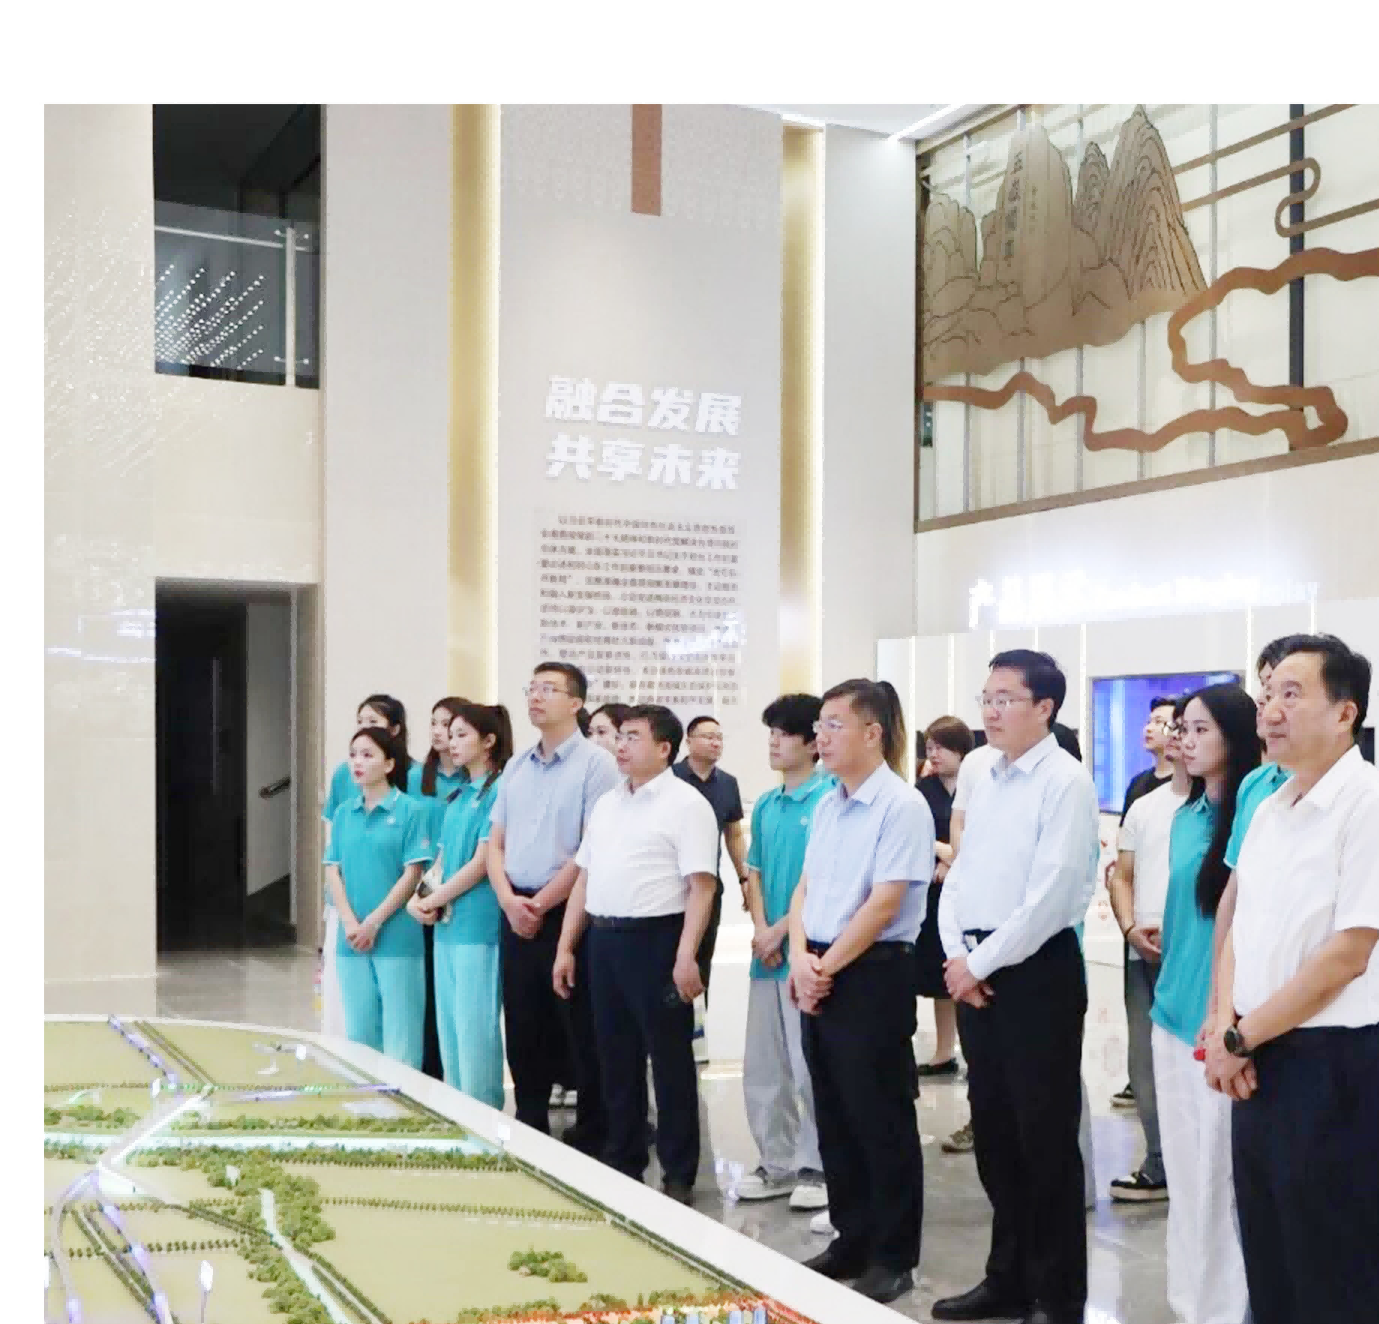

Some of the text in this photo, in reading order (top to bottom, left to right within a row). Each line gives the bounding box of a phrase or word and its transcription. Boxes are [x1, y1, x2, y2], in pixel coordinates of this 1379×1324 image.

[545, 375, 742, 436] 融合发展
[545, 432, 742, 490] 共享未来
